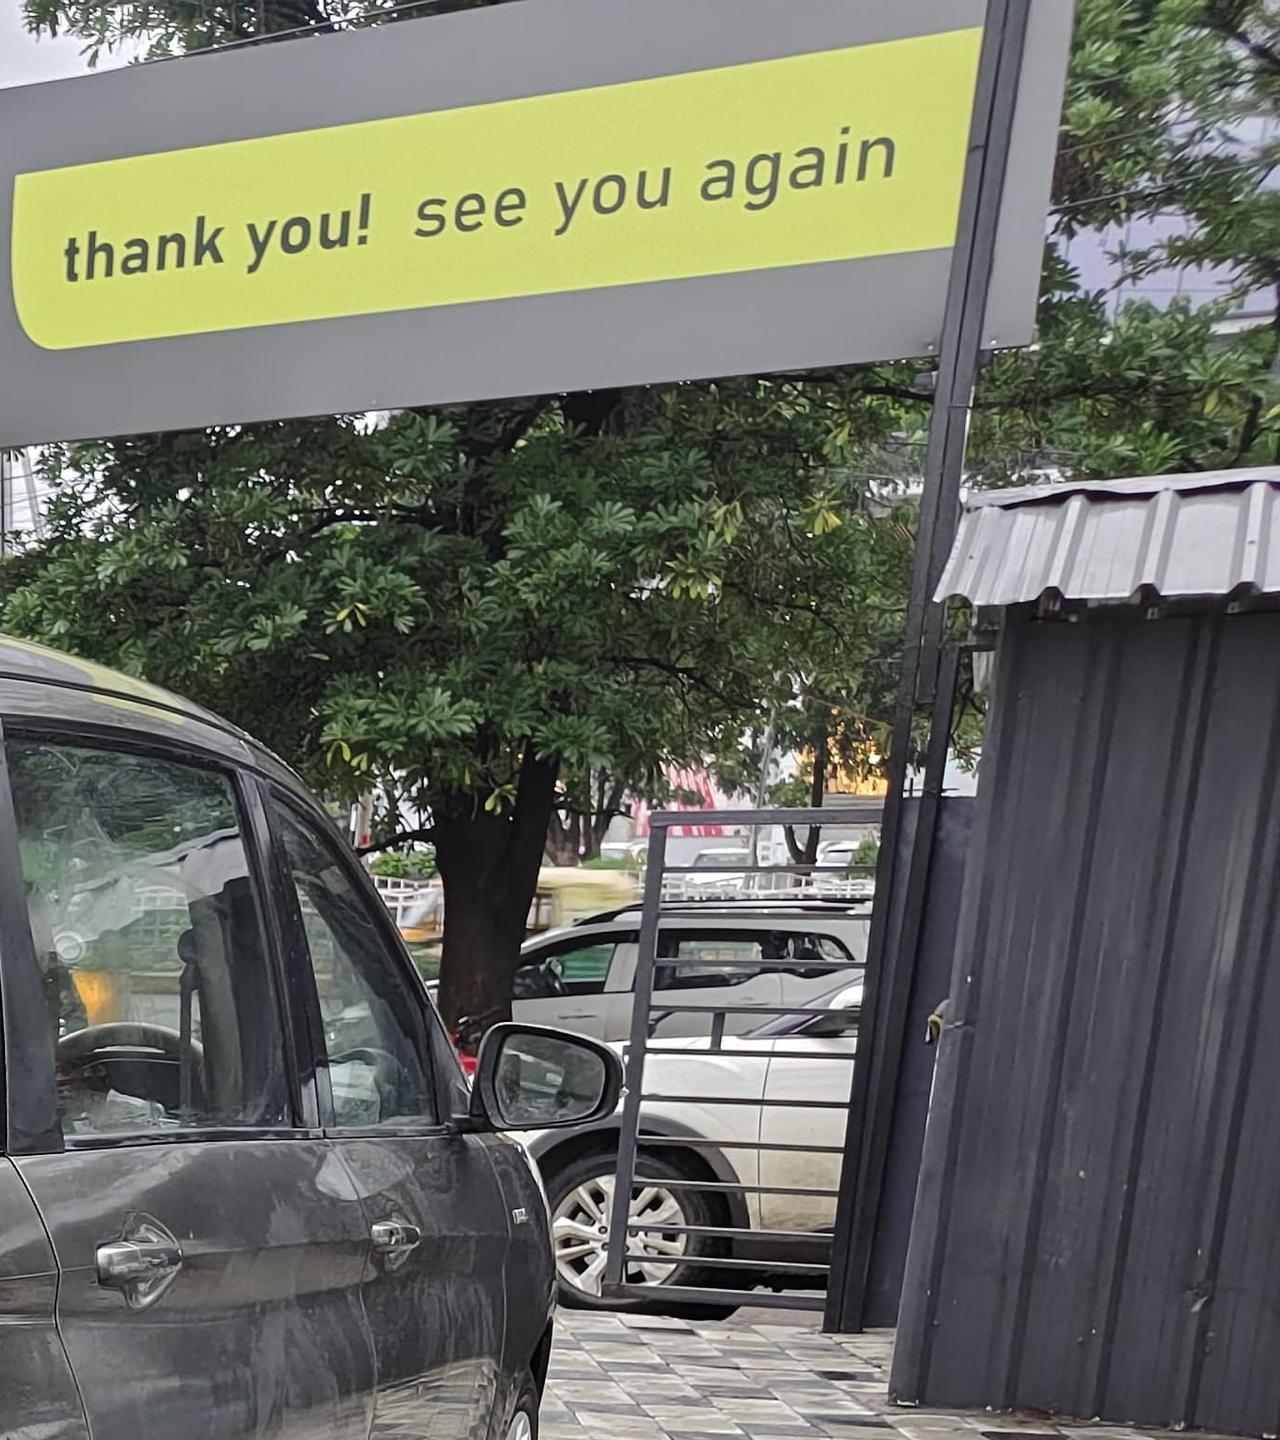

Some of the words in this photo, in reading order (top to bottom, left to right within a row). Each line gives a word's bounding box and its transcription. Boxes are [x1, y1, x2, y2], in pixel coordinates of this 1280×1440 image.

[63, 214, 227, 283] thank
[245, 192, 372, 275] you!
[413, 186, 528, 238] see
[554, 166, 673, 236] you
[699, 126, 896, 212] again
